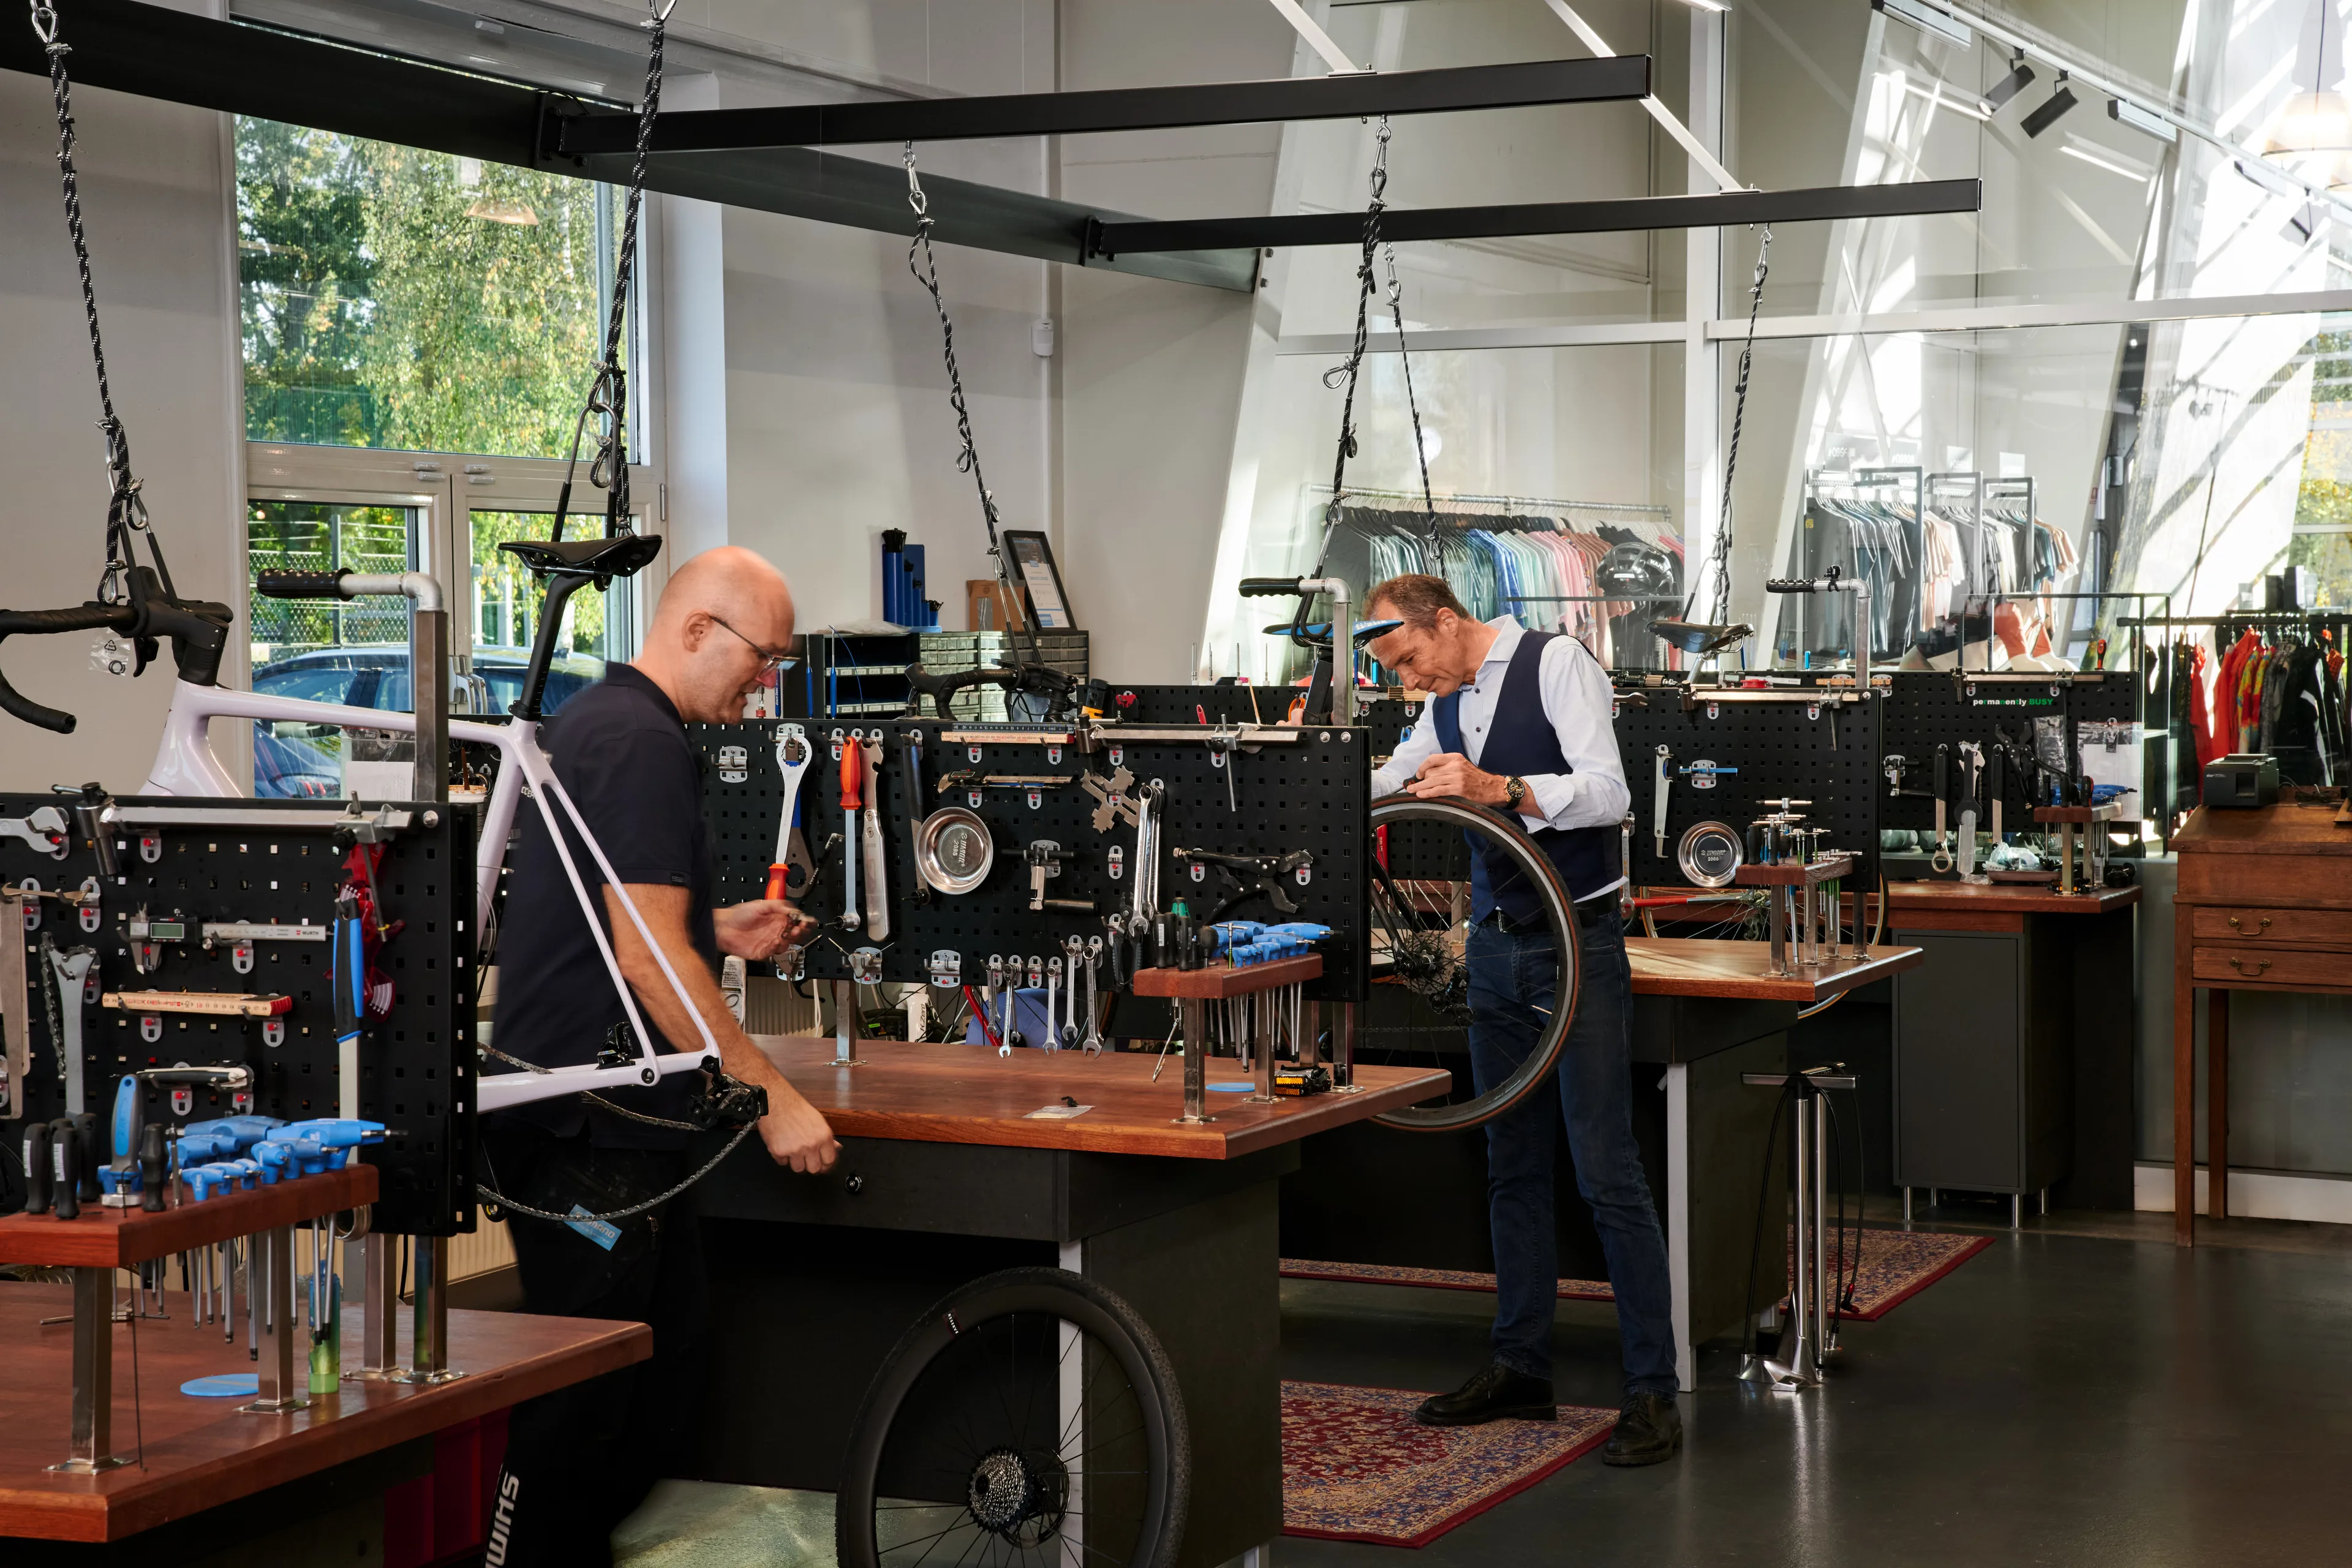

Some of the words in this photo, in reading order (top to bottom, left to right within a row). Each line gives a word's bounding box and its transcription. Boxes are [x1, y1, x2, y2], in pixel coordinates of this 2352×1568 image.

[1973, 698, 2027, 707] permanently
[948, 1313, 959, 1334] RESERVE
[485, 1470, 519, 1568] SHIM
